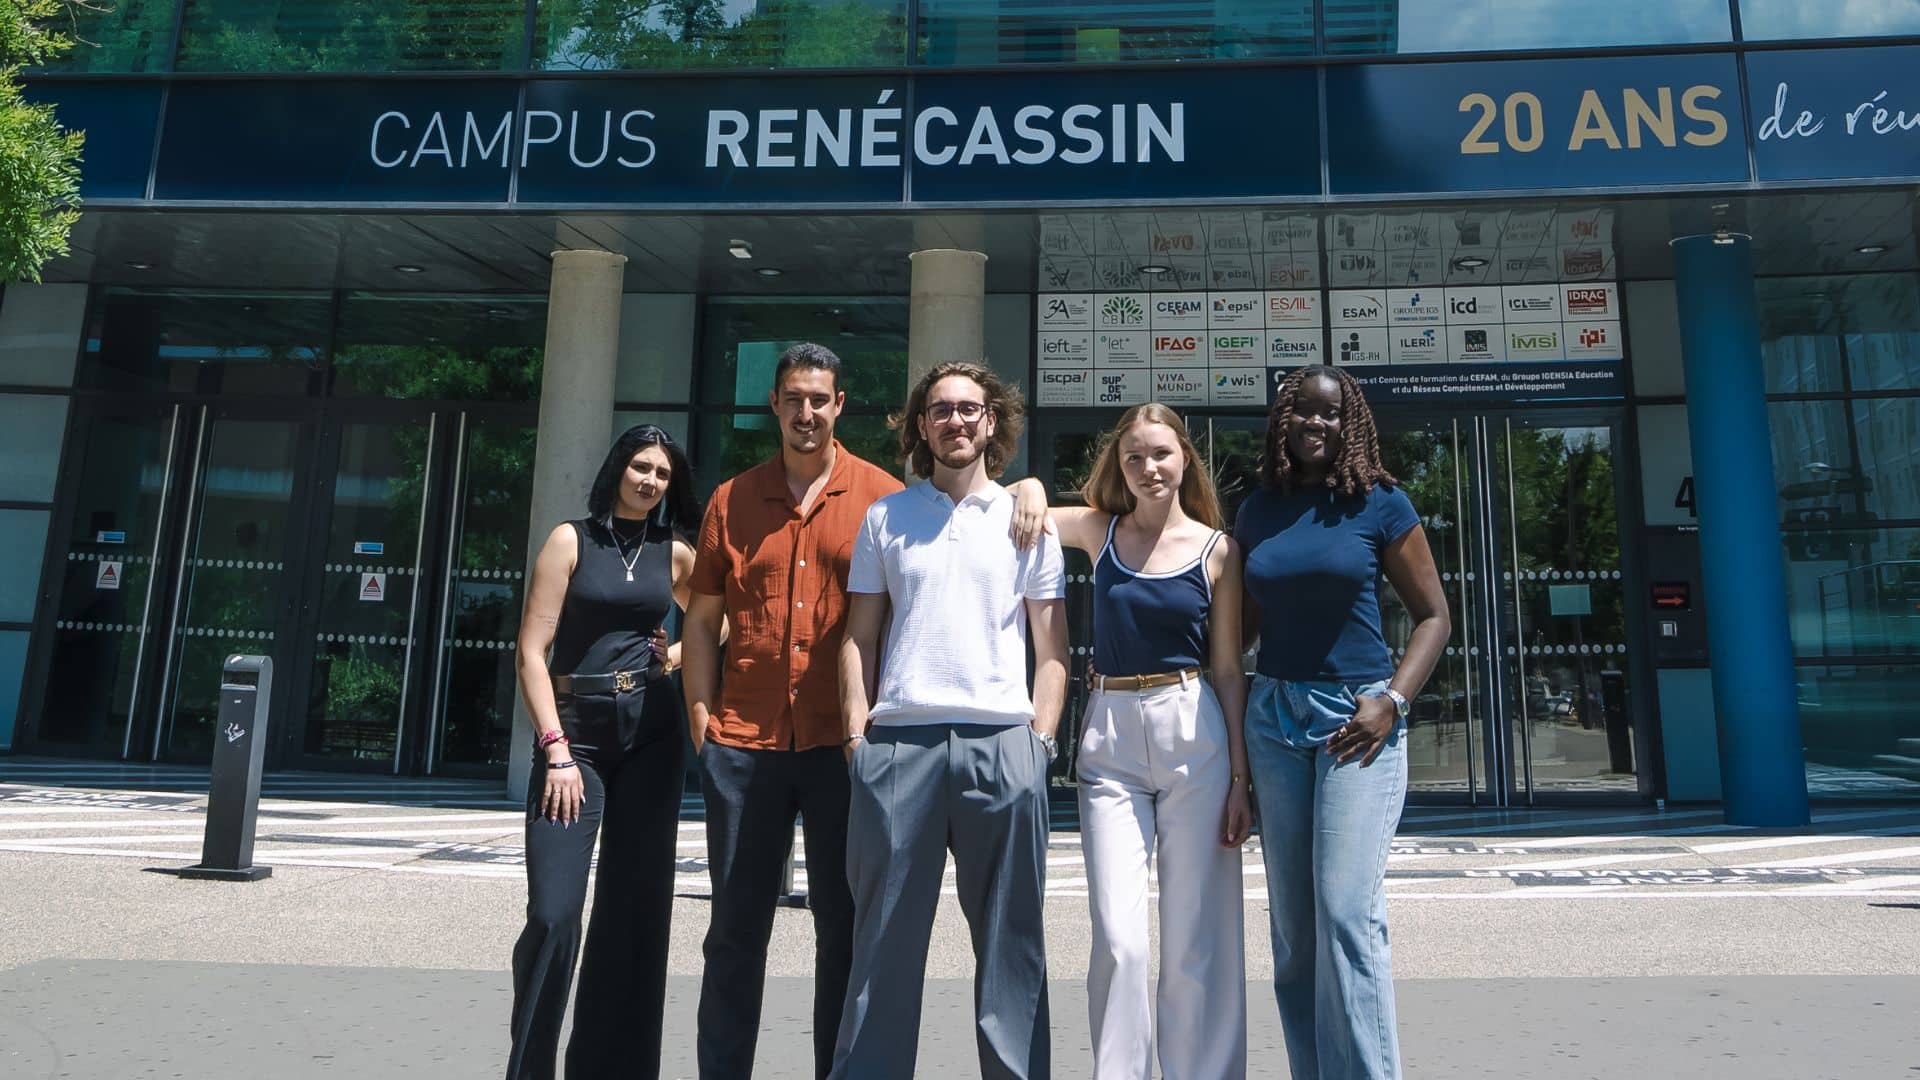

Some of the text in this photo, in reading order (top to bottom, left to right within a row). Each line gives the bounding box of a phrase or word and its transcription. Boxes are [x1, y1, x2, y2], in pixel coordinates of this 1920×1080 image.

[1458, 92, 1545, 154] 20
[1568, 85, 1728, 151] ANS
[1759, 82, 1825, 141] de
[370, 89, 1185, 168] CAMPUS RENÉ CASSIN
[1568, 290, 1605, 301] IDRAC
[1156, 301, 1201, 313] CEFAM
[1227, 301, 1253, 314] epsi
[1450, 297, 1477, 314] icd
[1342, 307, 1377, 318] ESAM
[1043, 338, 1070, 353] ieft
[1154, 336, 1196, 351] IFAG
[1214, 336, 1254, 348] IGEFI
[1271, 343, 1317, 352] IGENSIA
[1400, 338, 1430, 348] ILERI
[1157, 373, 1185, 382] VIVA
[1230, 374, 1255, 386] wis
[1378, 376, 1408, 384] Centres
[1409, 375, 1419, 383] de
[1420, 375, 1458, 383] formation
[1459, 374, 1469, 382] du
[1501, 373, 1511, 381] du
[1512, 373, 1540, 382] Groupe
[1541, 372, 1574, 380] IGENSIA
[1108, 385, 1121, 393] DE
[1157, 383, 1197, 392] MUNDI
[1412, 385, 1441, 393] Réseau
[1442, 384, 1494, 394] Compétences
[1504, 382, 1565, 392] Développement
[1099, 393, 1121, 402] COM
